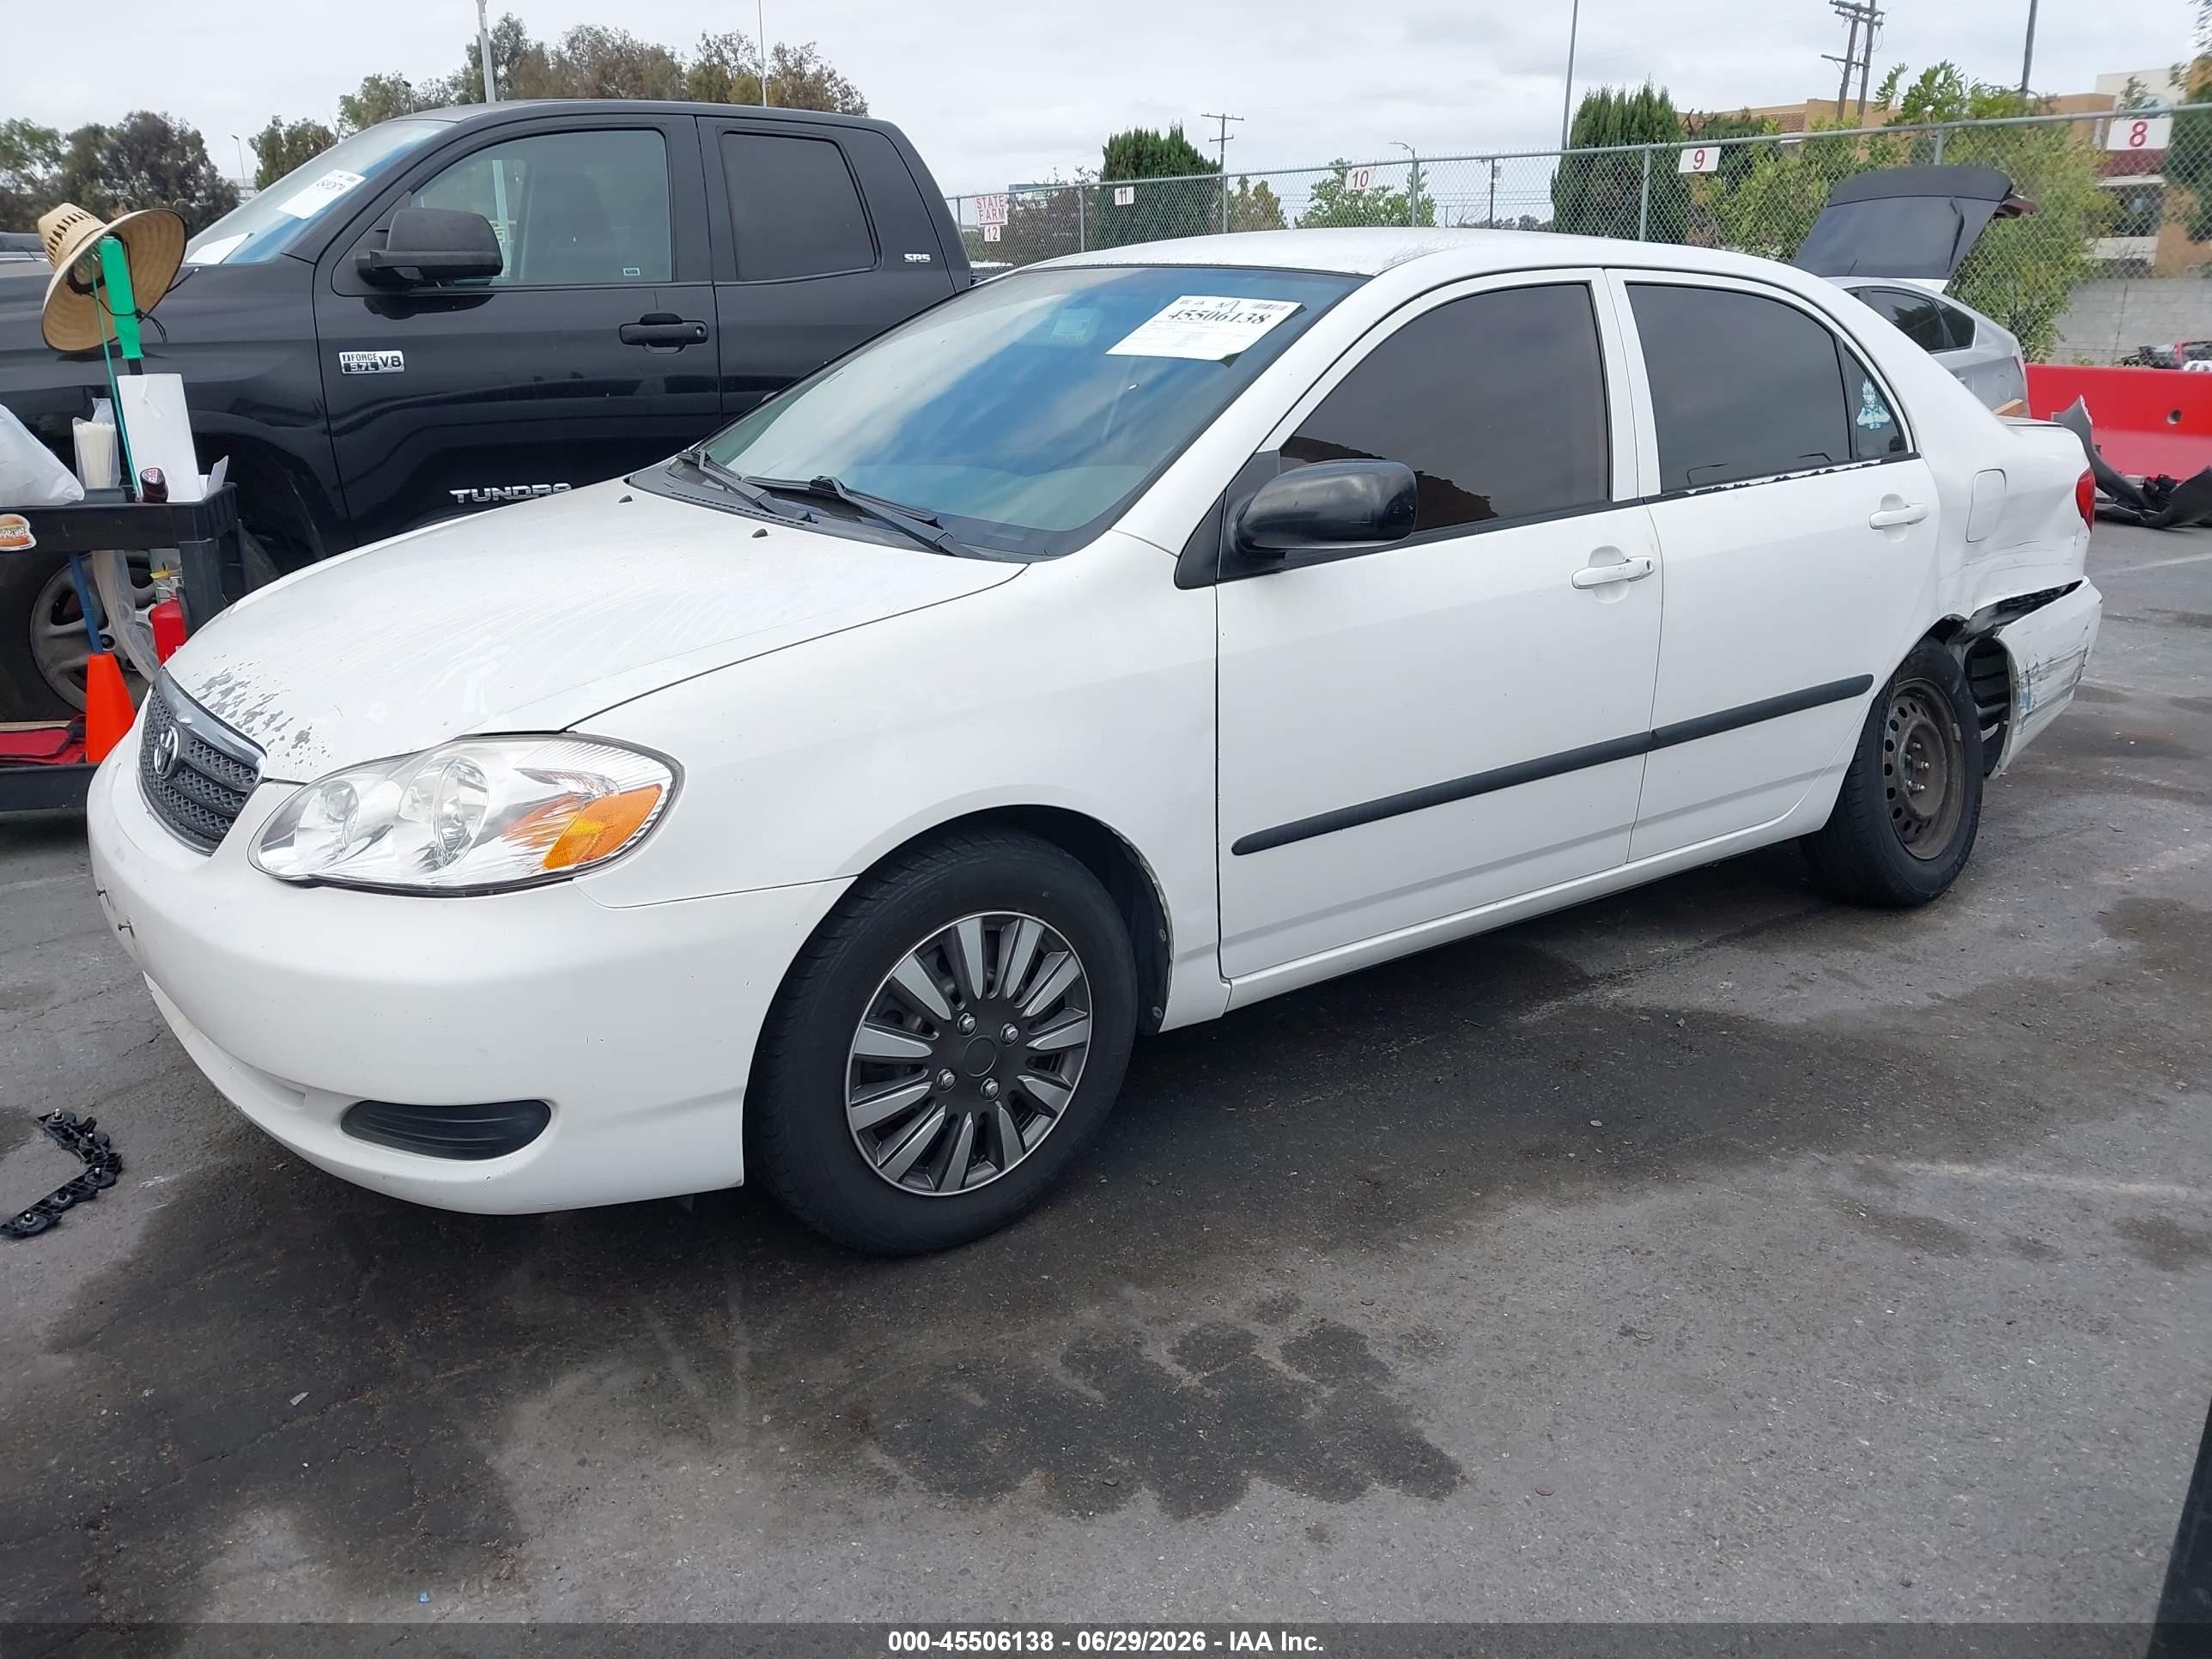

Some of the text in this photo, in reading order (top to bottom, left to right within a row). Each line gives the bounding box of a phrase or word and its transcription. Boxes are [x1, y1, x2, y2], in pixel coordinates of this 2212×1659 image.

[2130, 121, 2148, 148] 8
[1693, 149, 1705, 170] 9
[1352, 170, 1369, 188] 10
[976, 195, 1004, 209] STATE
[1119, 188, 1127, 204] 11
[979, 208, 1005, 221] FARM
[988, 227, 998, 240] 12
[1169, 308, 1271, 325] 45506138
[379, 356, 402, 368] V8
